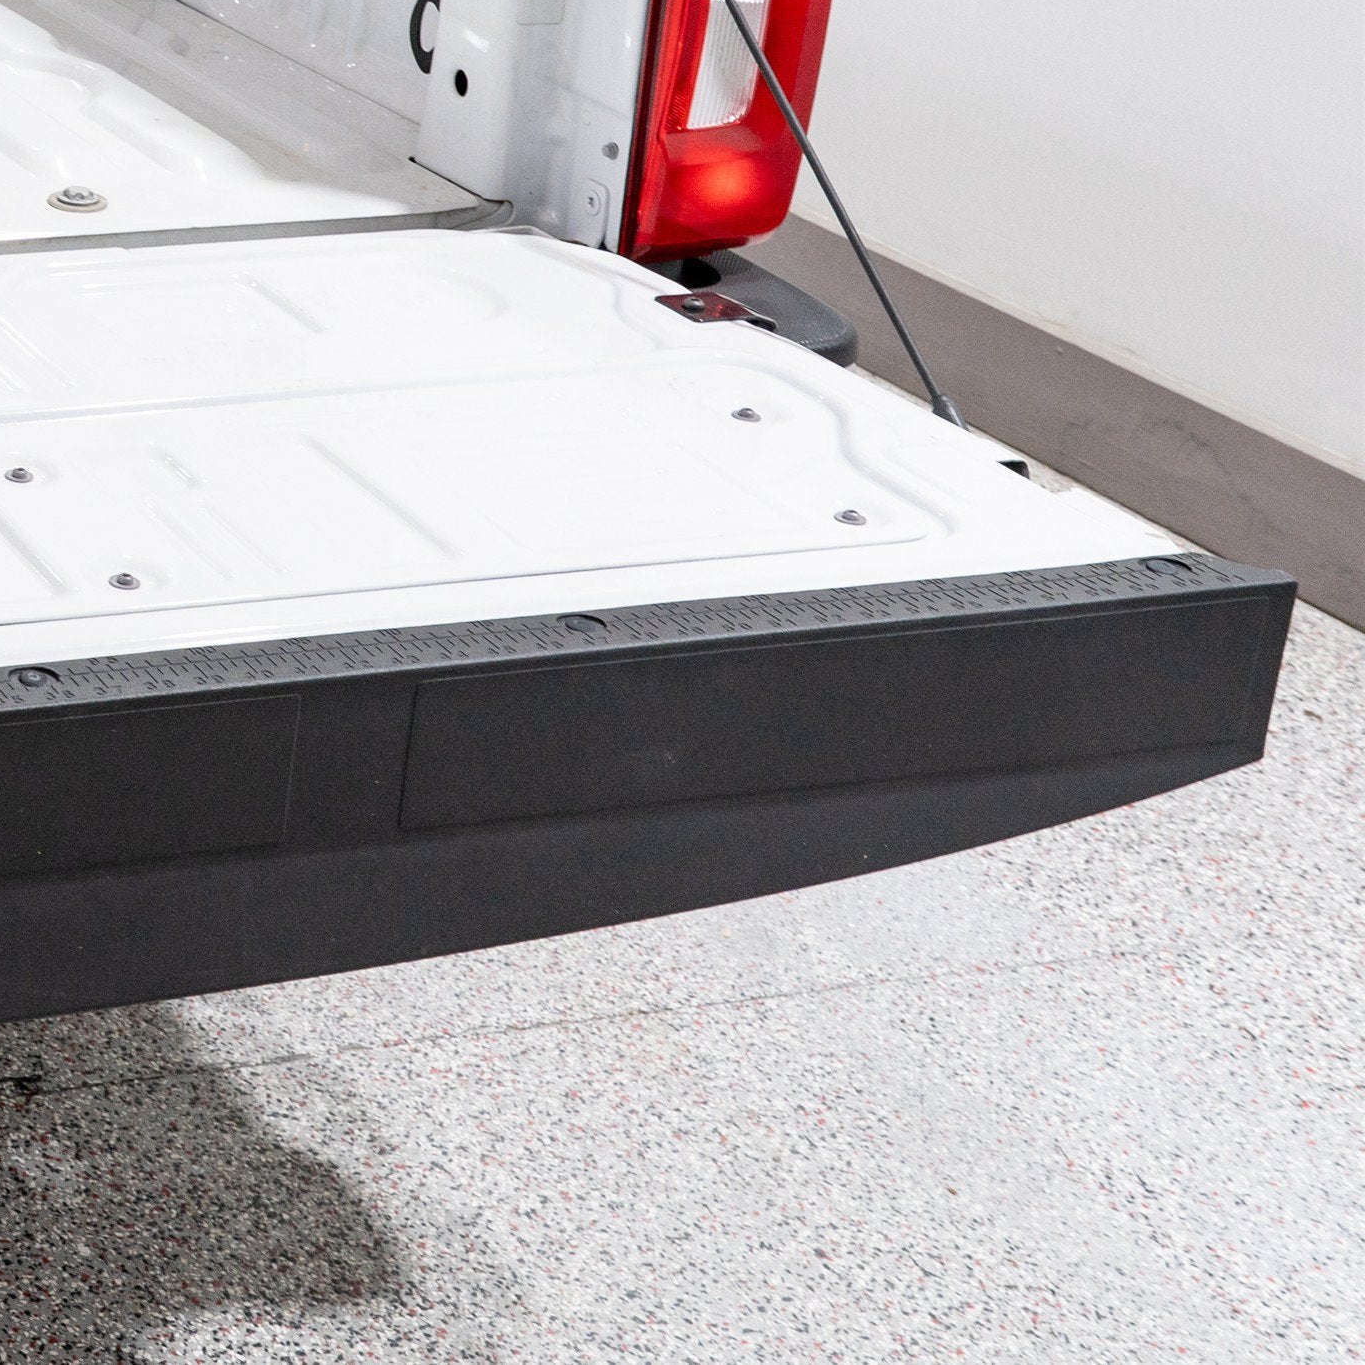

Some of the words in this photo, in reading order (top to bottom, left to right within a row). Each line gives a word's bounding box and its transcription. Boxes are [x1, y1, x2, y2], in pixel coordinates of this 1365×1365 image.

[86, 657, 119, 666] 95
[186, 646, 217, 655] 100
[282, 638, 312, 646] 105
[377, 628, 402, 637] 110
[43, 689, 75, 702] 36
[92, 685, 123, 696] 37
[142, 679, 177, 691] 38
[192, 674, 226, 685] 39
[245, 669, 275, 680] 40
